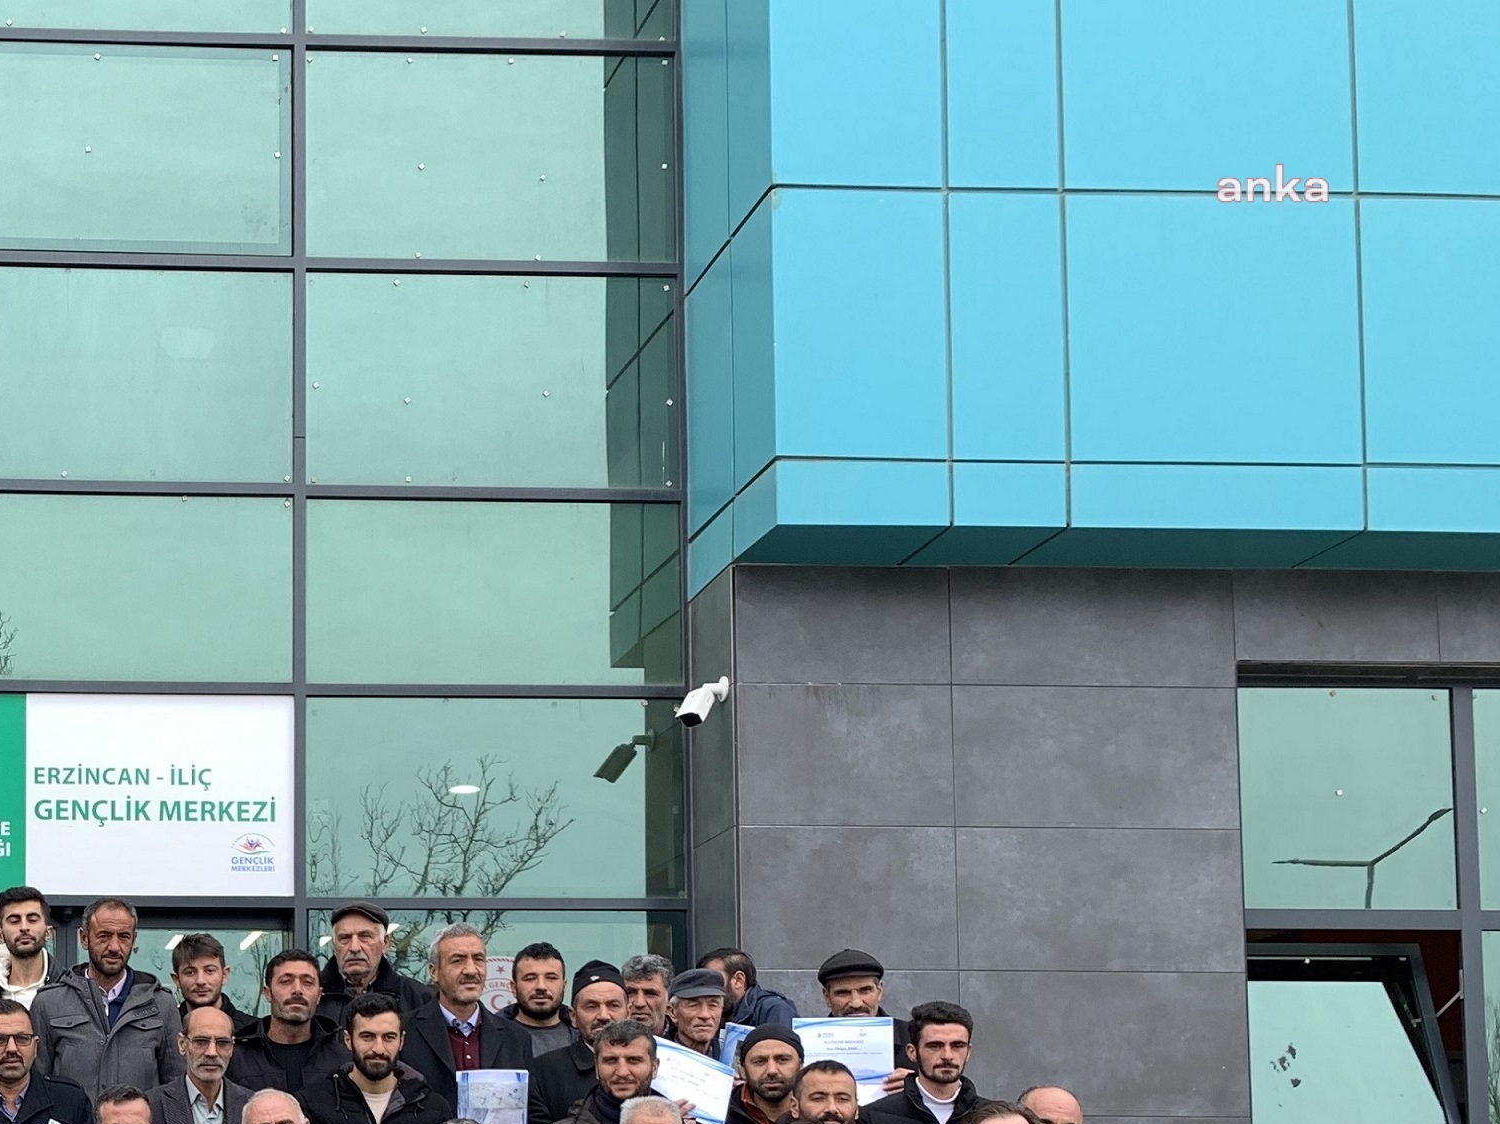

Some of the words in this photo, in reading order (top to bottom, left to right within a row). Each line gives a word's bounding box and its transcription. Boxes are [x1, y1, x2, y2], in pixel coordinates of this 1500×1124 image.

[34, 764, 150, 786] ERZİNCAN
[171, 765, 212, 791] İLİÇ
[34, 795, 151, 828] GENÇLİK
[159, 797, 276, 823] MERKEZİ
